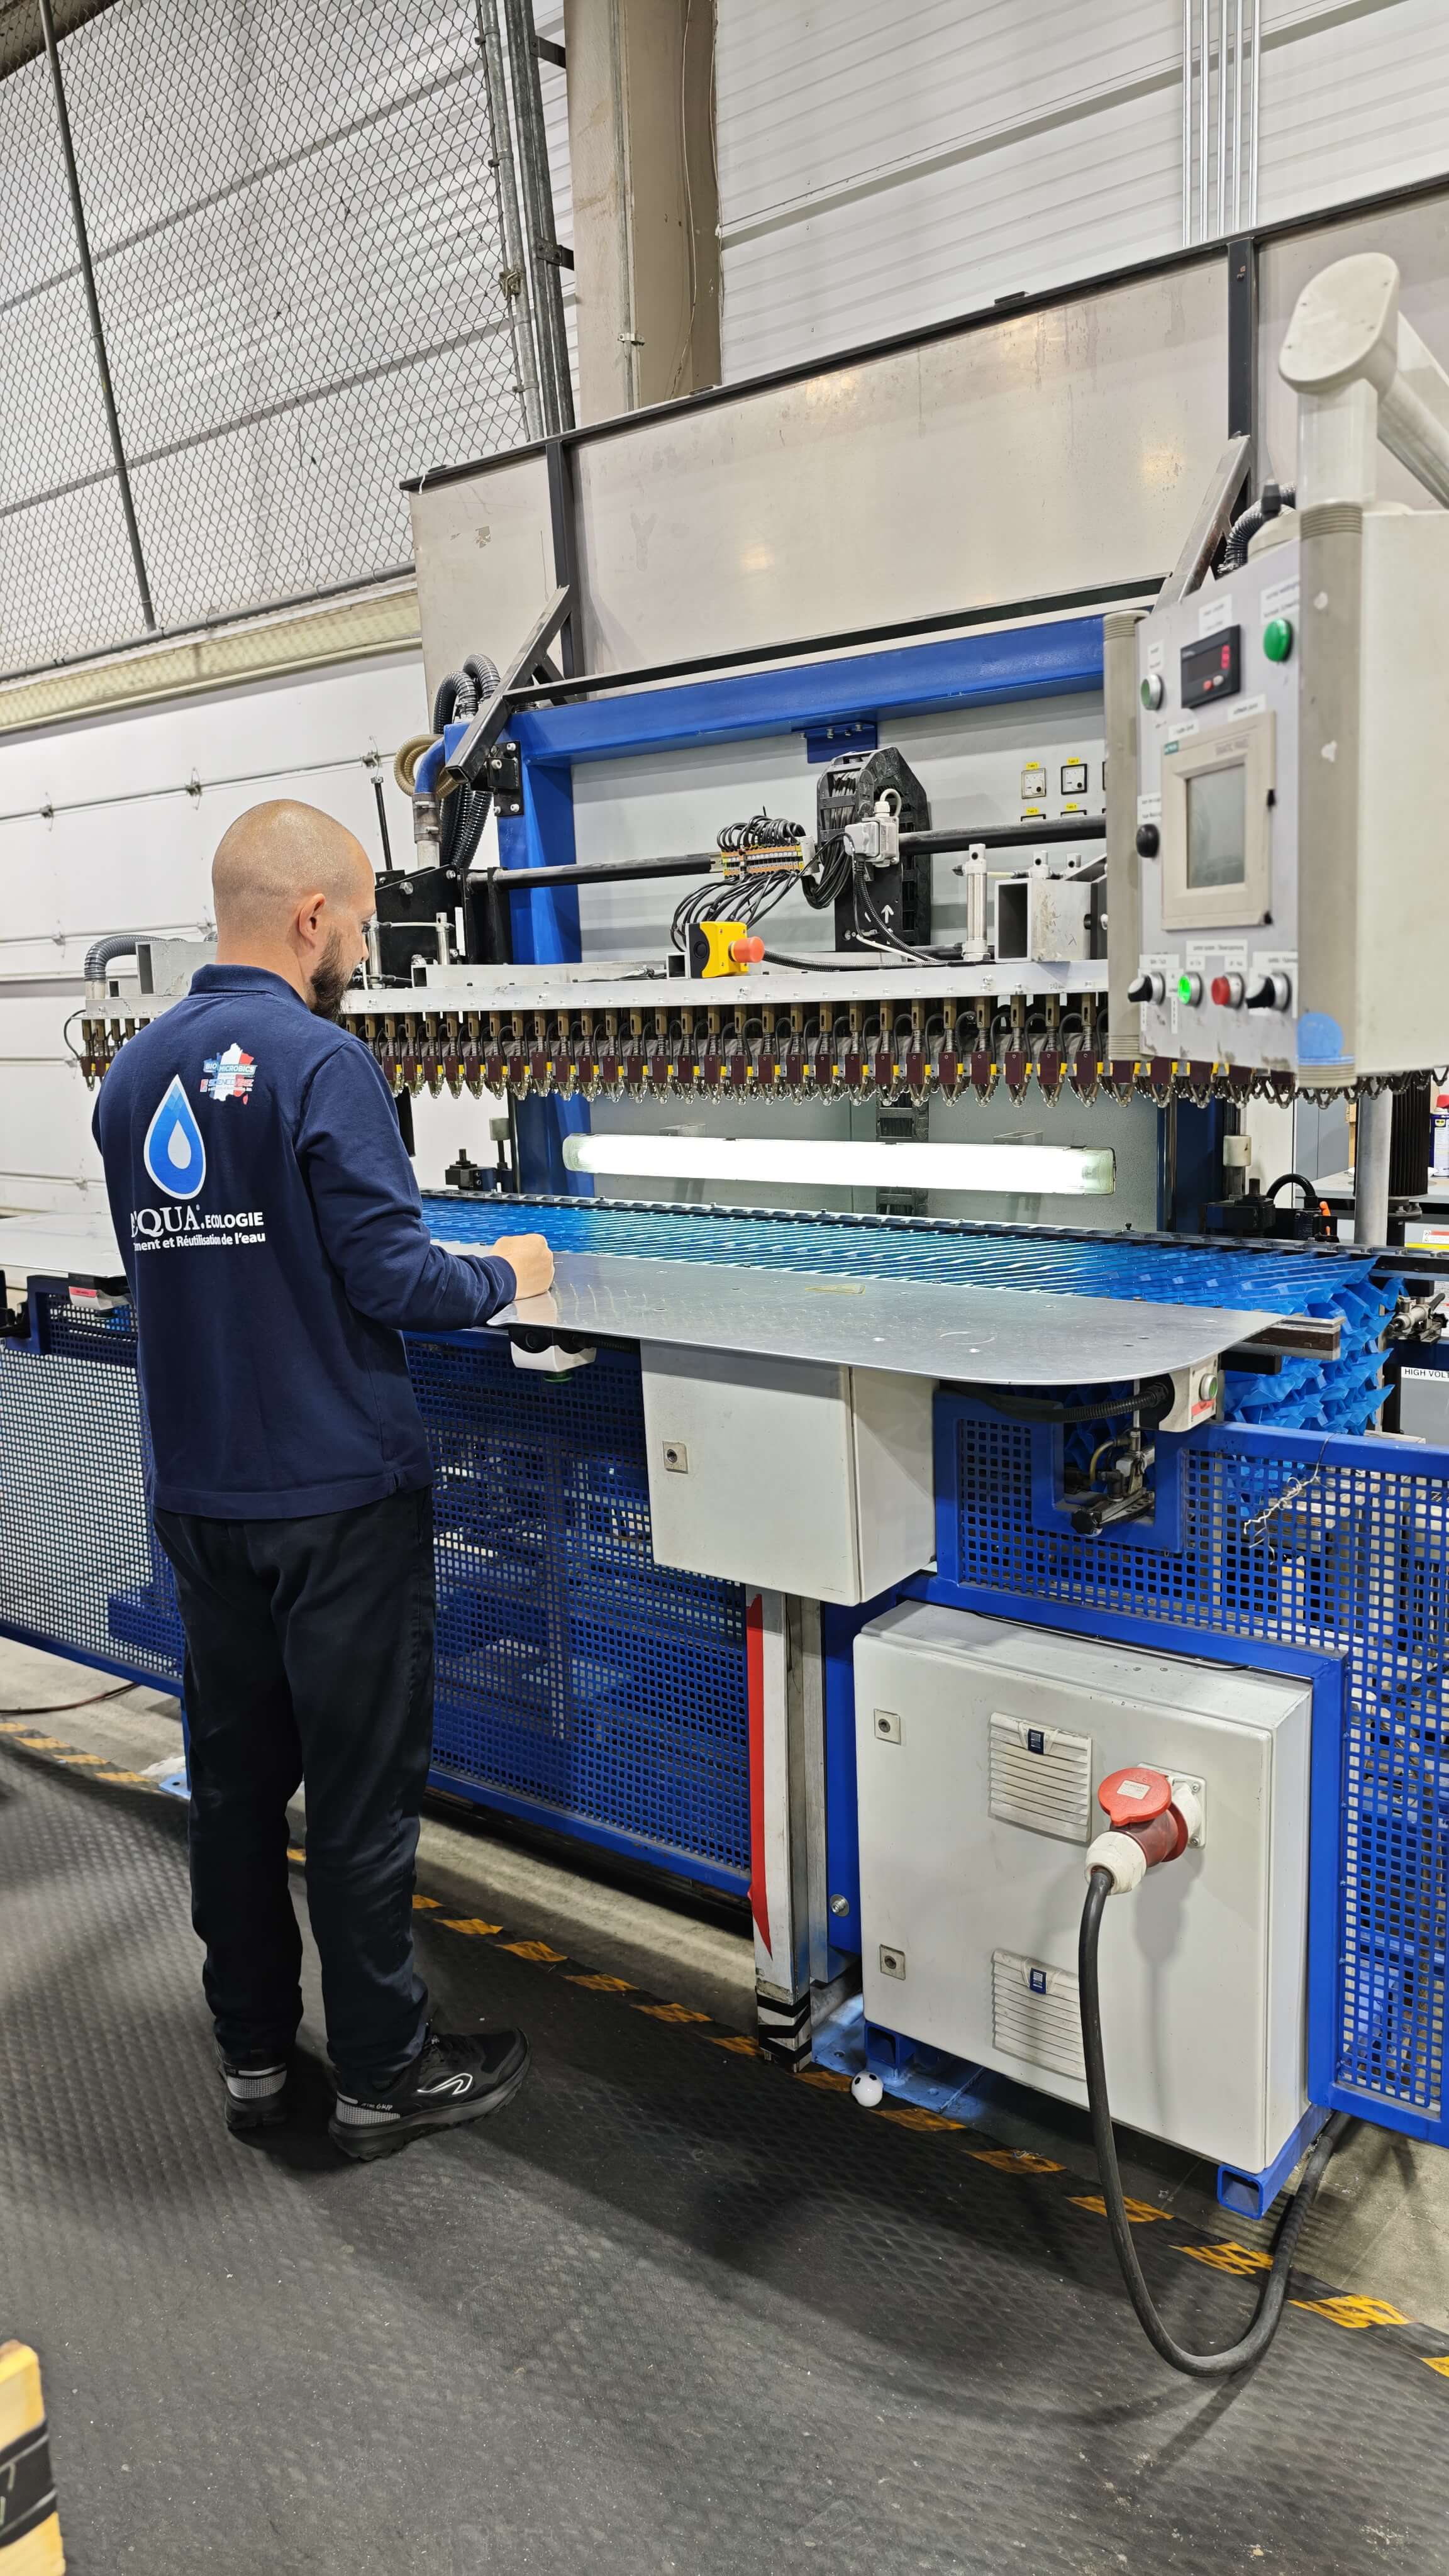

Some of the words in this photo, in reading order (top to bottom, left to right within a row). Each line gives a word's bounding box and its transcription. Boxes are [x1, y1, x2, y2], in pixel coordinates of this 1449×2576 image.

[219, 1065, 254, 1073] MICROBICS
[162, 1237, 175, 1248] et
[176, 1234, 221, 1248] Réutilisation
[221, 1233, 233, 1245] de
[235, 1232, 265, 1245] l'eau
[1404, 1368, 1426, 1376] HIGH
